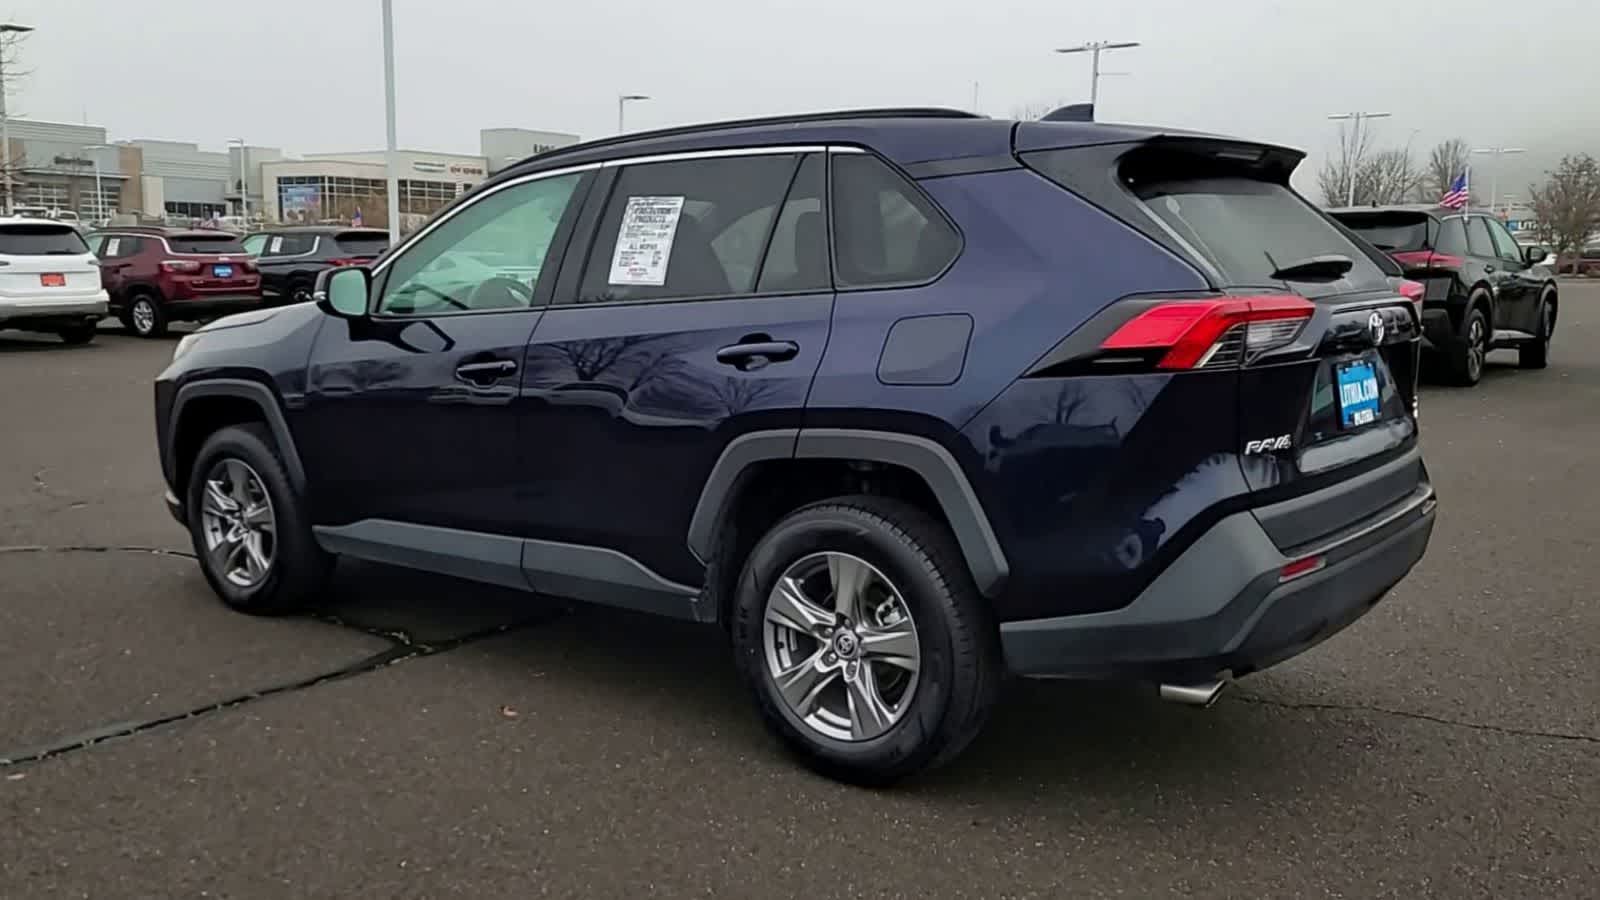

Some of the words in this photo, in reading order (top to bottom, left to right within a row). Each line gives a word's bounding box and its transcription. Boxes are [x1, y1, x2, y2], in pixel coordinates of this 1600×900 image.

[1518, 220, 1552, 231] LITA
[1339, 377, 1379, 408] LITHIA.COM
[1244, 434, 1291, 455] RAV4
